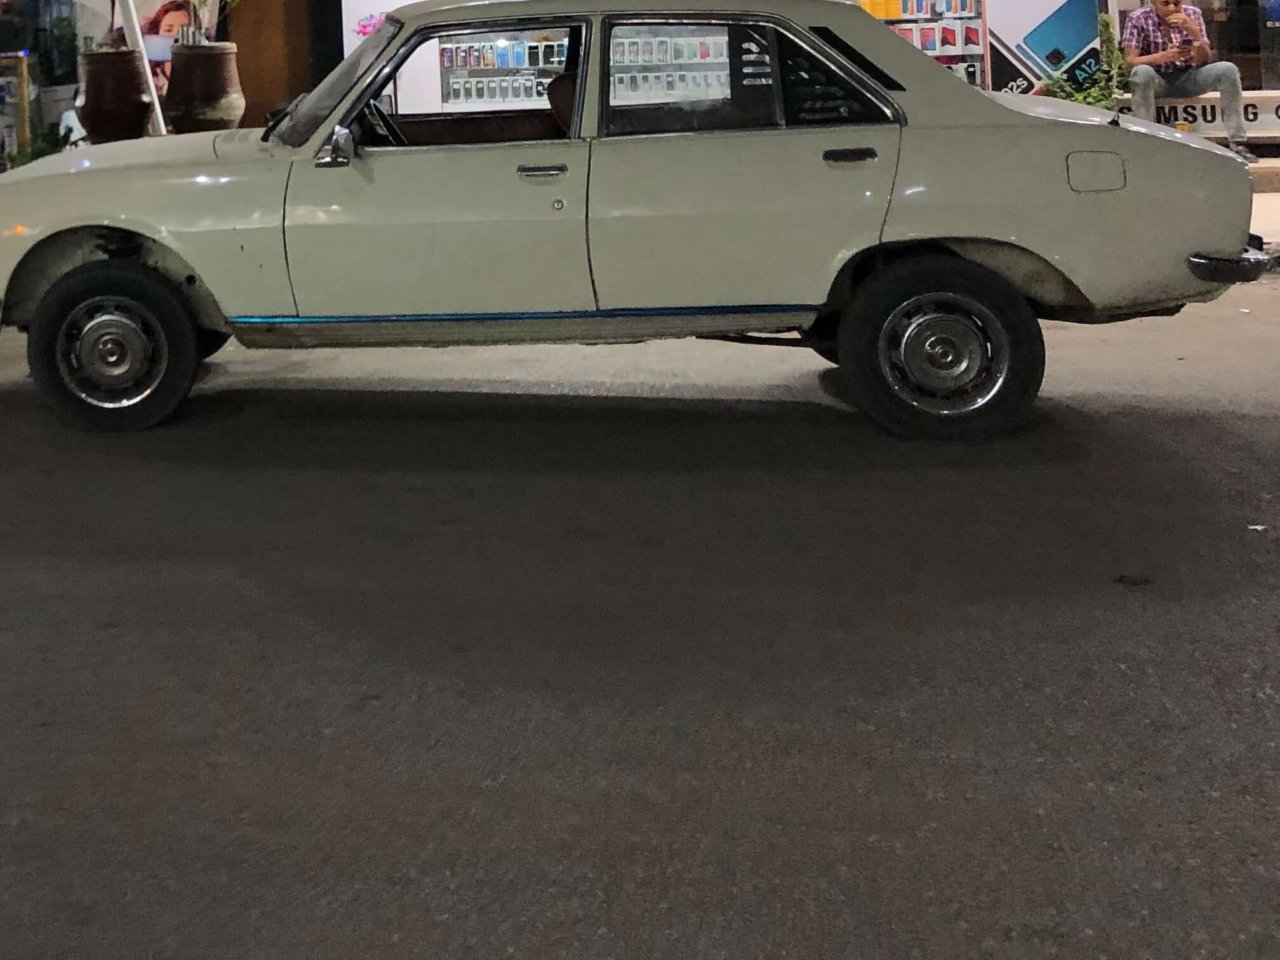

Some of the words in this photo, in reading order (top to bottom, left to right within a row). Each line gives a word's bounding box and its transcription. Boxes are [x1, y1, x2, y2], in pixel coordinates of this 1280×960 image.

[1074, 58, 1100, 82] A12
[1001, 77, 1027, 94] 2s
[1118, 104, 1259, 124] MSUG
